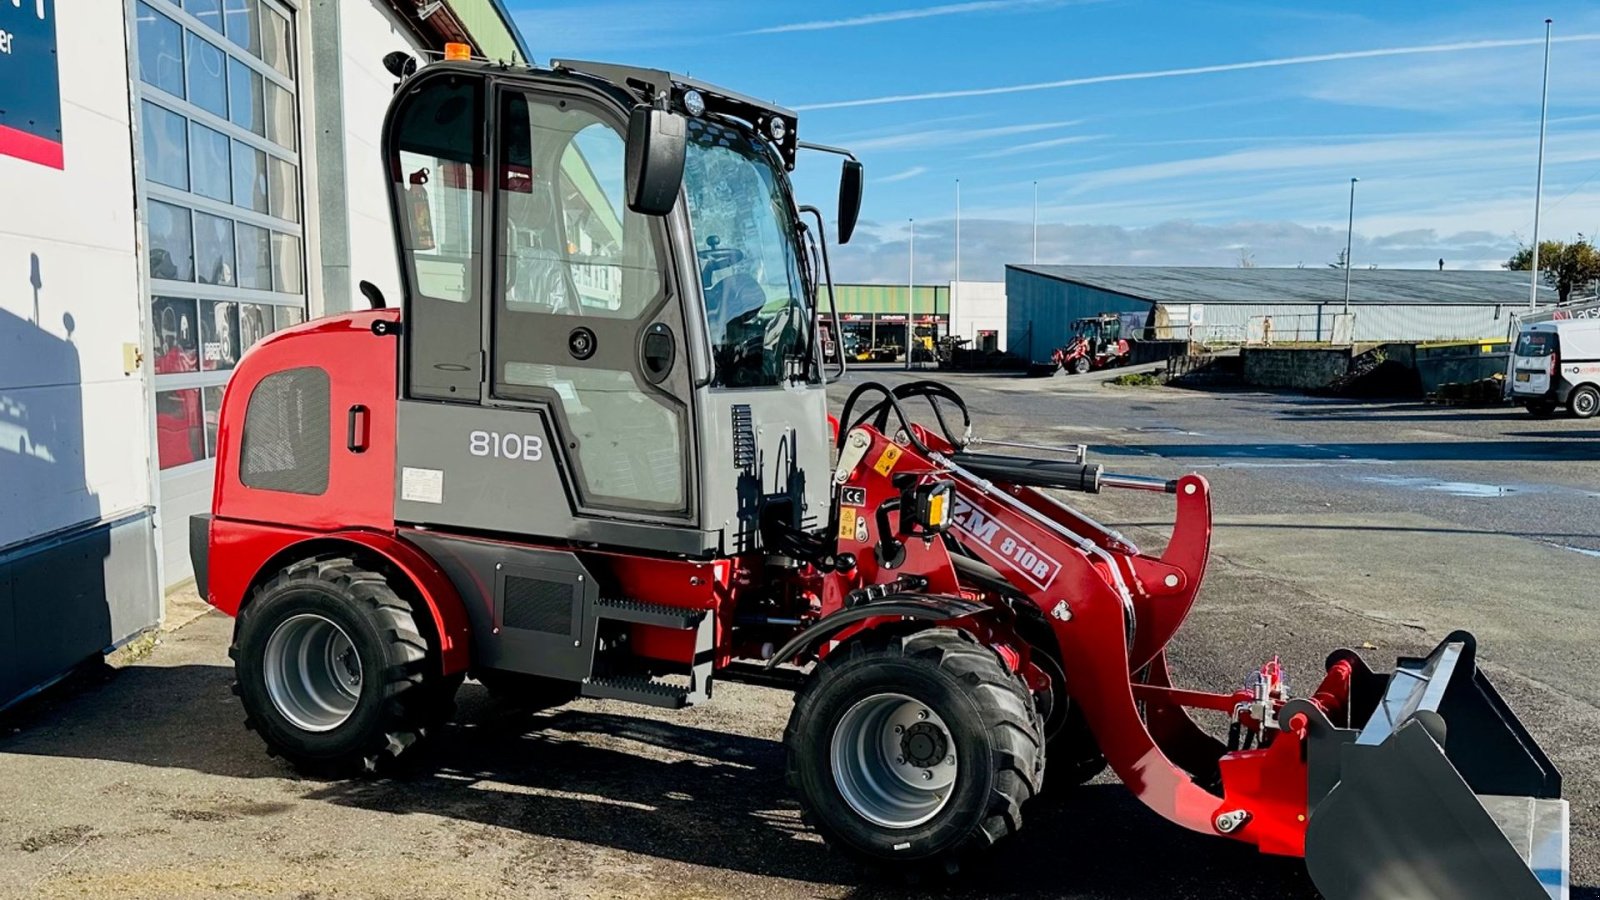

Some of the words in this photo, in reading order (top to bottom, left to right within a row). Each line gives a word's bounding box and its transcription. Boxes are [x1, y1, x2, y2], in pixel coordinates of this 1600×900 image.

[1567, 308, 1600, 320] Lars
[469, 430, 543, 462] 810B
[846, 491, 861, 503] CE
[1000, 537, 1050, 580] 810B
